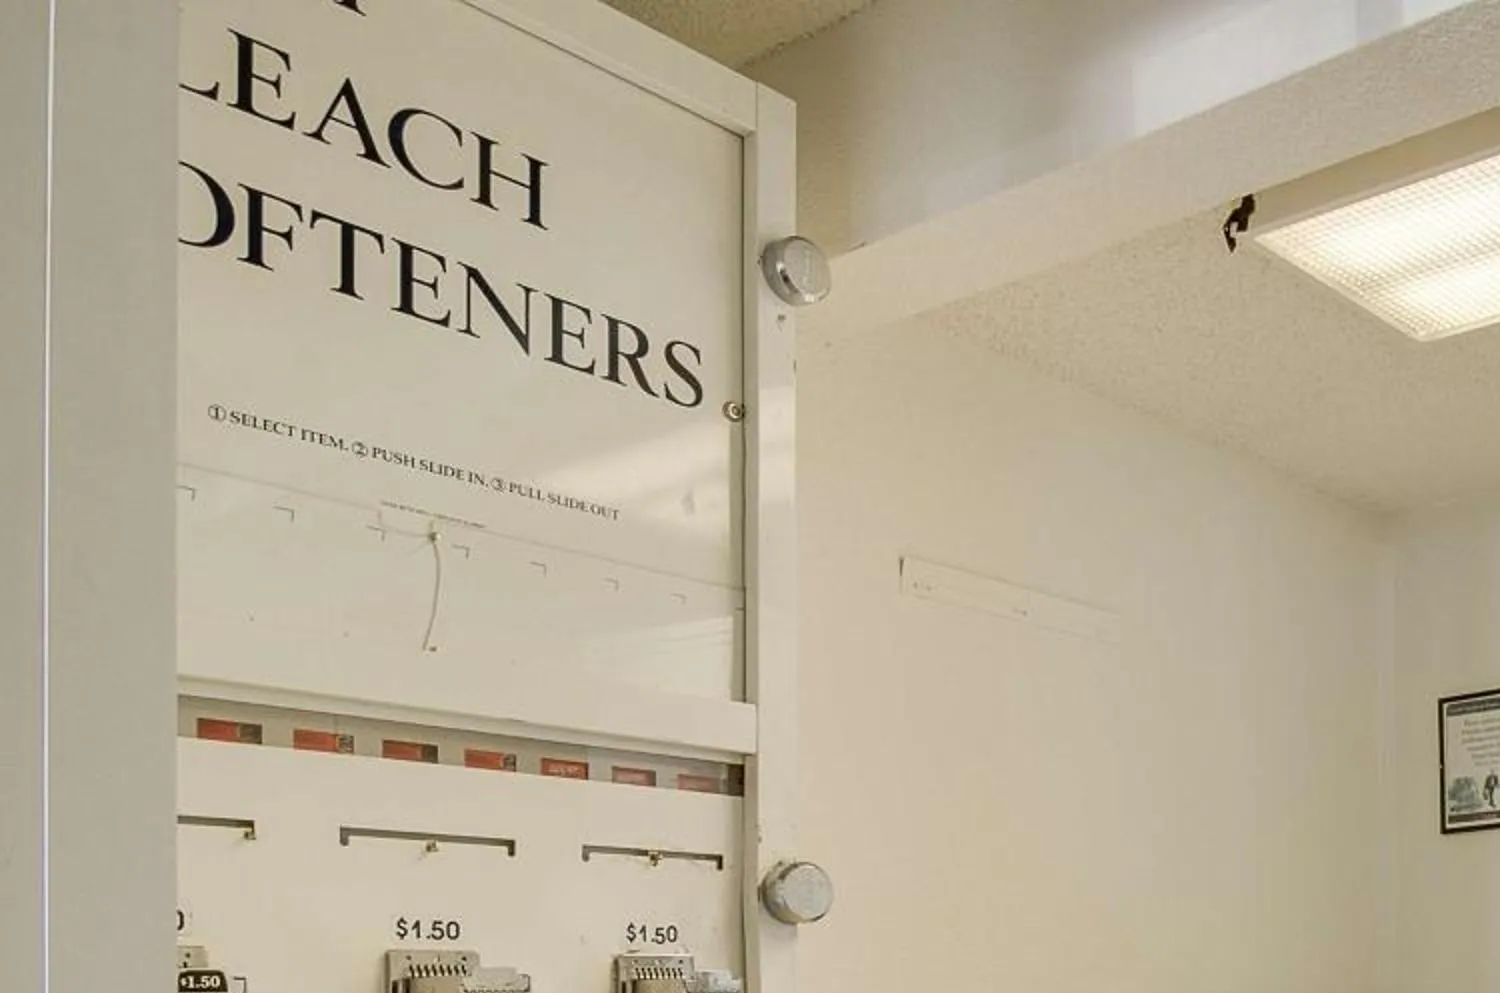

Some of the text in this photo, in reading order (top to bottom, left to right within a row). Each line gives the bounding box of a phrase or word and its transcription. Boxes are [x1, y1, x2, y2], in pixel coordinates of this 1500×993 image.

[229, 409, 297, 438] SELECT
[372, 446, 417, 469] PUSH
[419, 458, 466, 481] SLIDE
[508, 481, 546, 502] PULL
[546, 491, 591, 513] SLIDE
[590, 503, 621, 522] OUT
[396, 918, 461, 941] $1.50
[626, 922, 679, 945] $1.50
